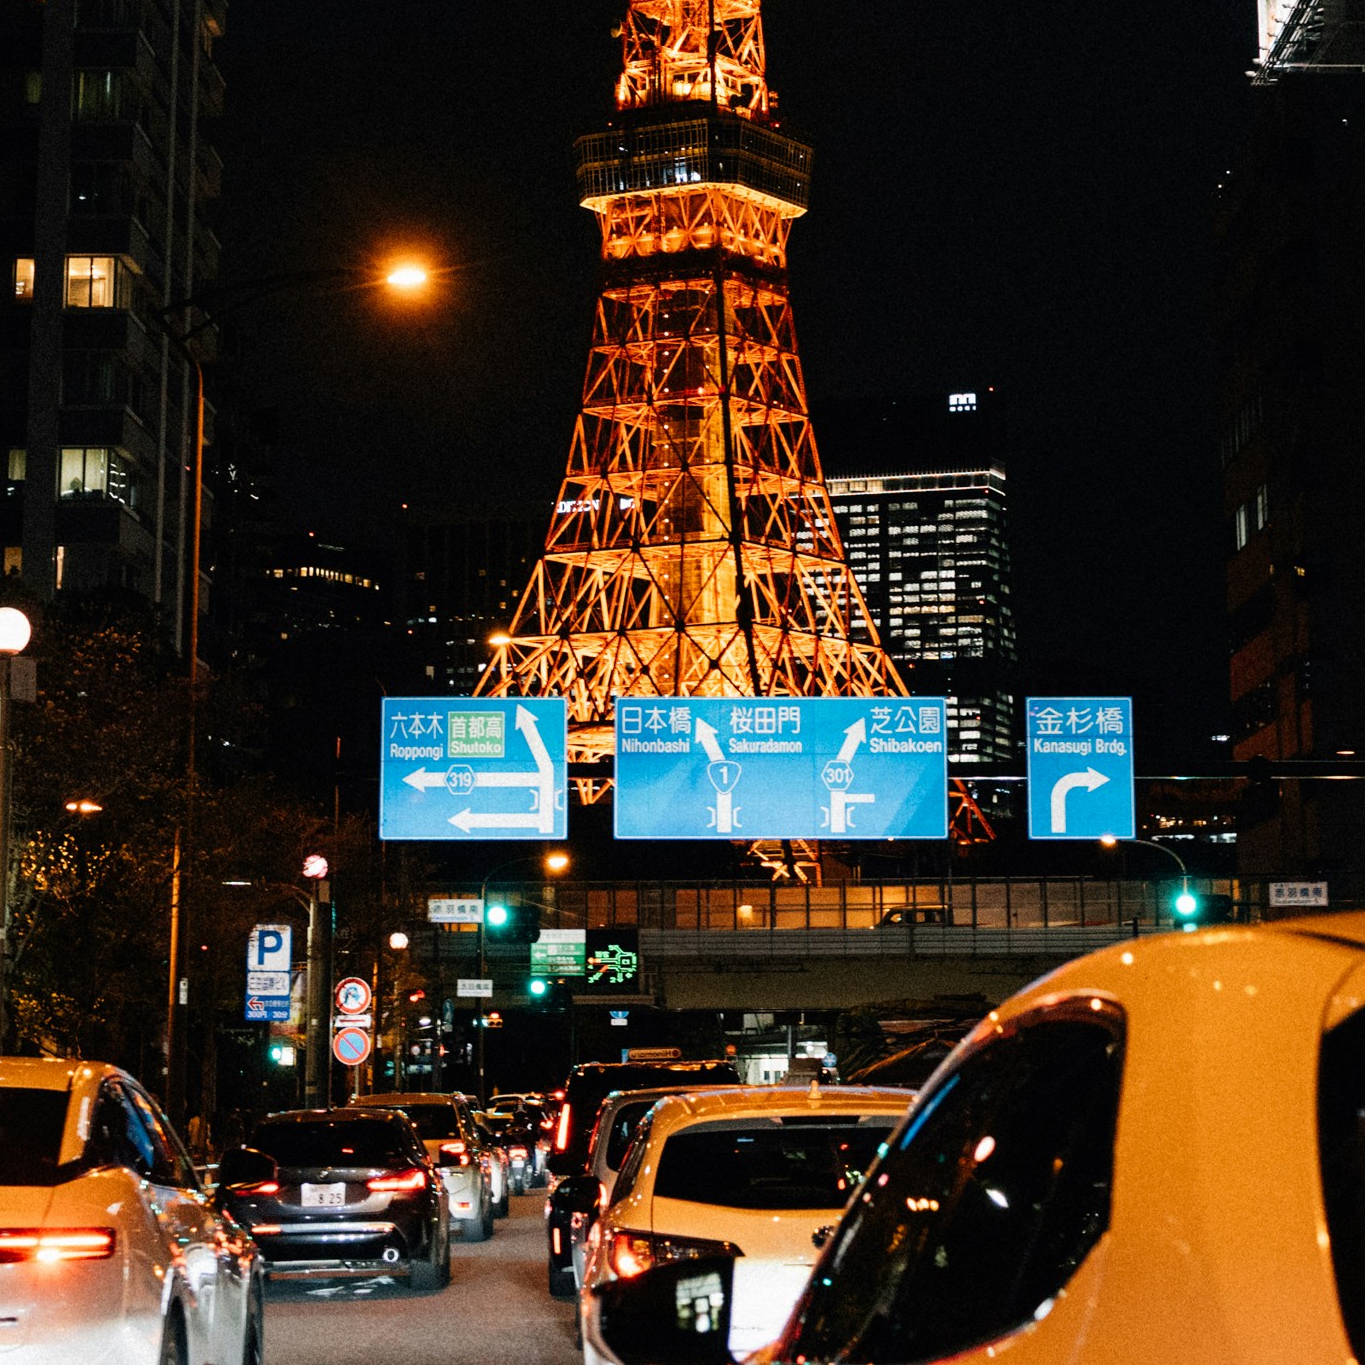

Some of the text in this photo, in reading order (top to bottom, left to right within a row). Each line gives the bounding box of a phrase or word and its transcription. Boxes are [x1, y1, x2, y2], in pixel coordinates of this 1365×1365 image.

[390, 712, 502, 739] 六本木 首都高
[621, 706, 941, 735] 日本橋 桜田門 芝公園
[1036, 706, 1124, 735] 金杉橋
[390, 740, 501, 761] Roppongi Shutoko
[621, 738, 942, 753] Nihonbashi Sakuradamon Shibakoen
[1034, 738, 1128, 756] Kanasugi Brdg.
[448, 772, 472, 787] 319
[719, 765, 728, 784] 1
[827, 768, 850, 783] 301
[257, 930, 283, 965] P
